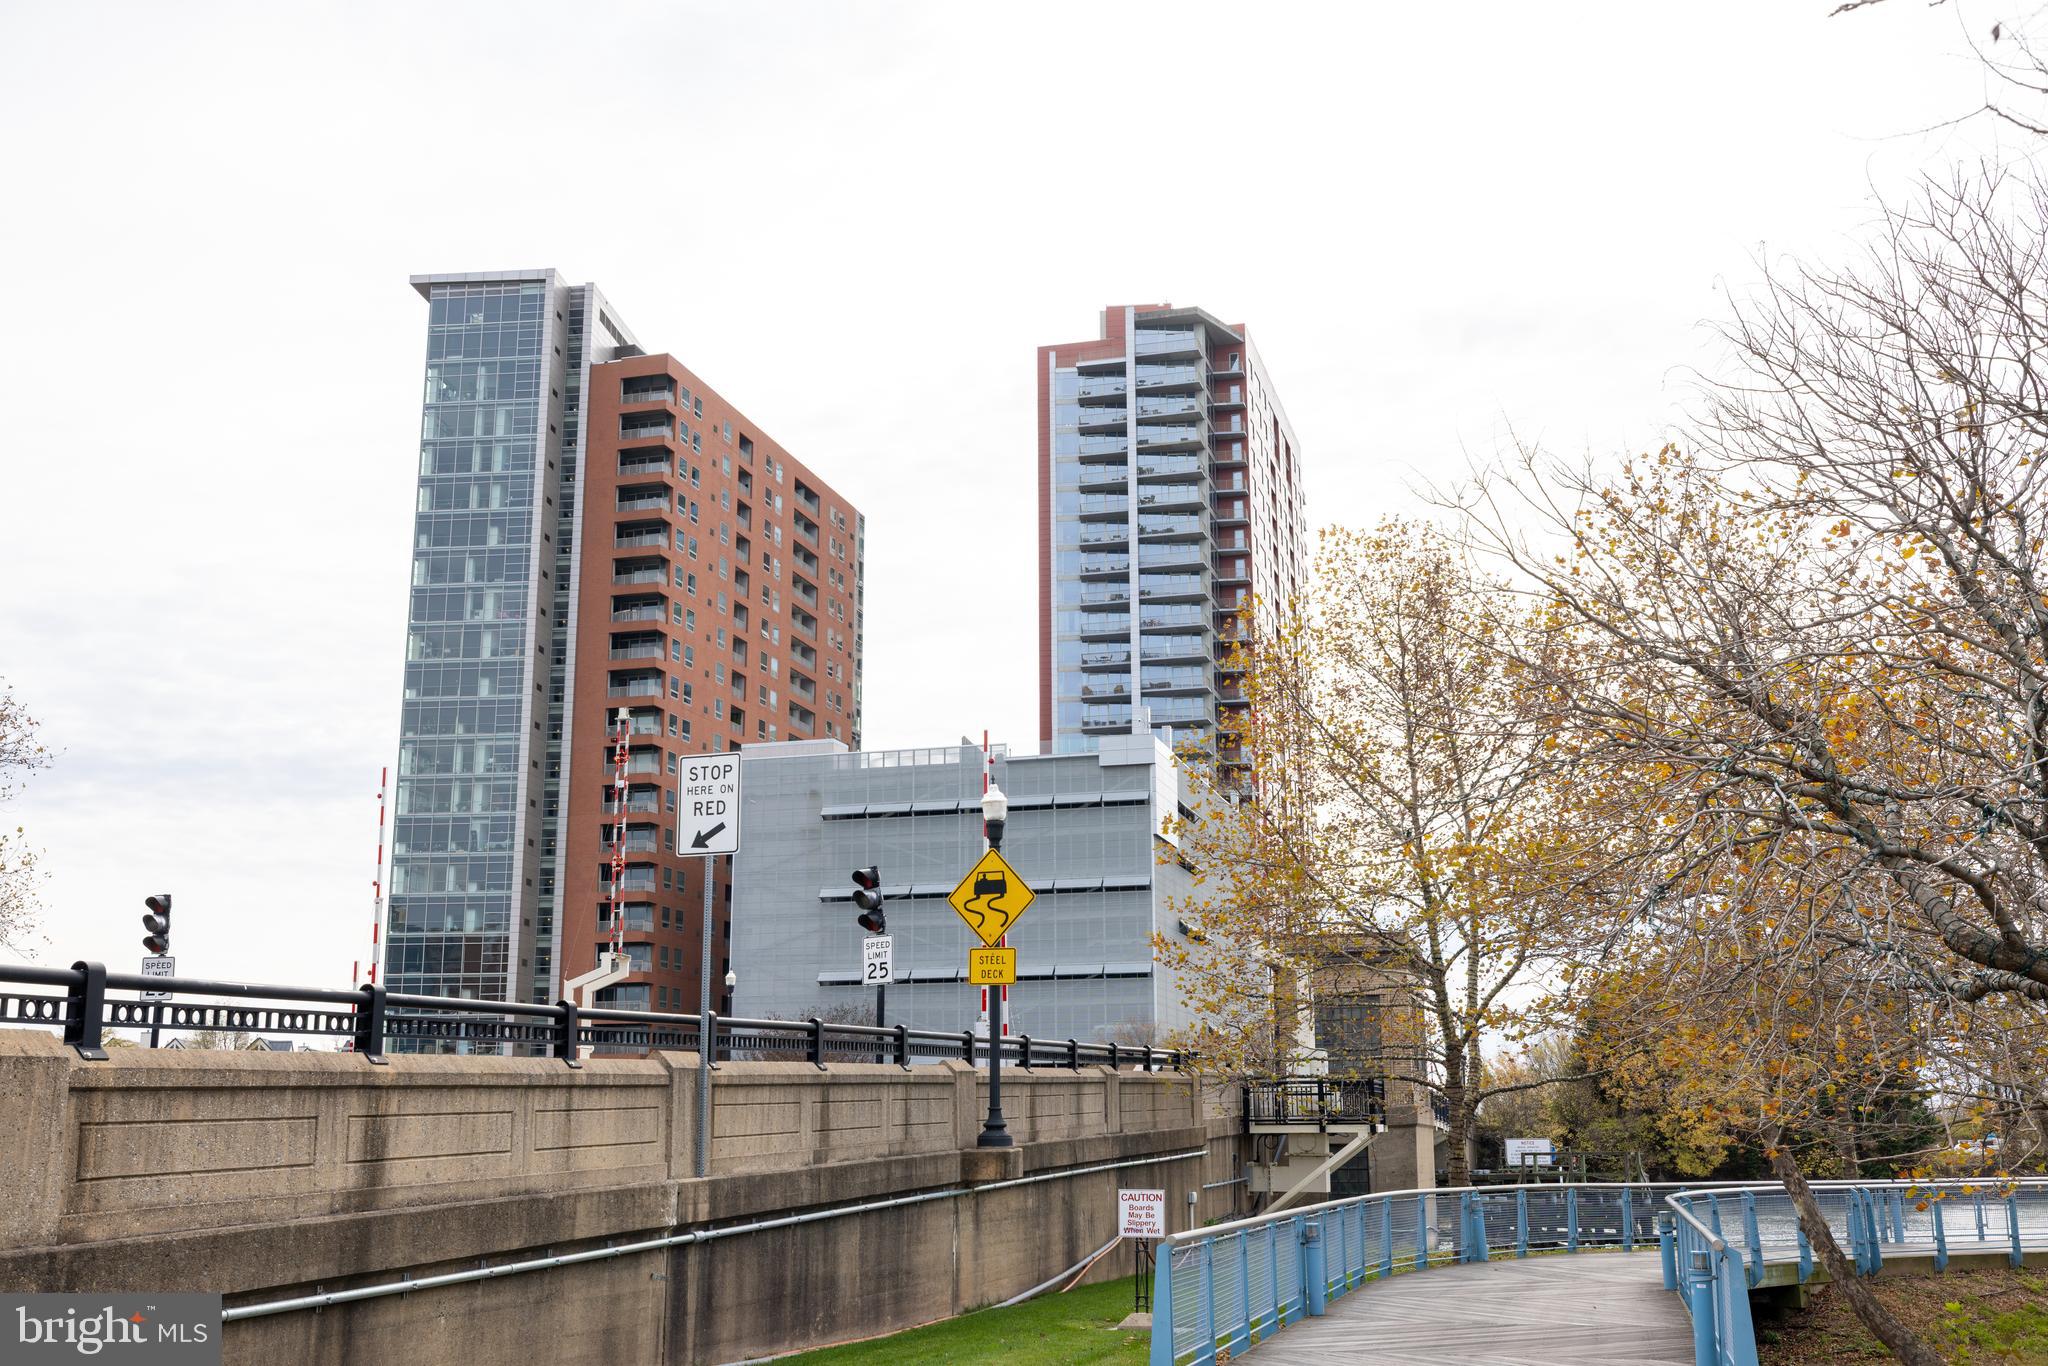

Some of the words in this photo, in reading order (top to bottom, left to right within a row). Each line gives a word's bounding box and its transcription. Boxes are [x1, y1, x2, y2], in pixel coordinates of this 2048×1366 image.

[689, 765, 733, 781] STOP
[687, 785, 714, 796] HERE
[720, 784, 734, 794] ON
[694, 800, 726, 817] RED
[865, 941, 891, 950] SPEED
[867, 951, 888, 960] LIMIT
[979, 955, 1007, 965] STEEL
[145, 962, 172, 970] SPEED
[867, 962, 889, 979] 25
[981, 969, 1004, 979] DECK
[1121, 1193, 1162, 1201] CAUTION
[1128, 1212, 1143, 1220] May
[1127, 1219, 1157, 1227] Slippery
